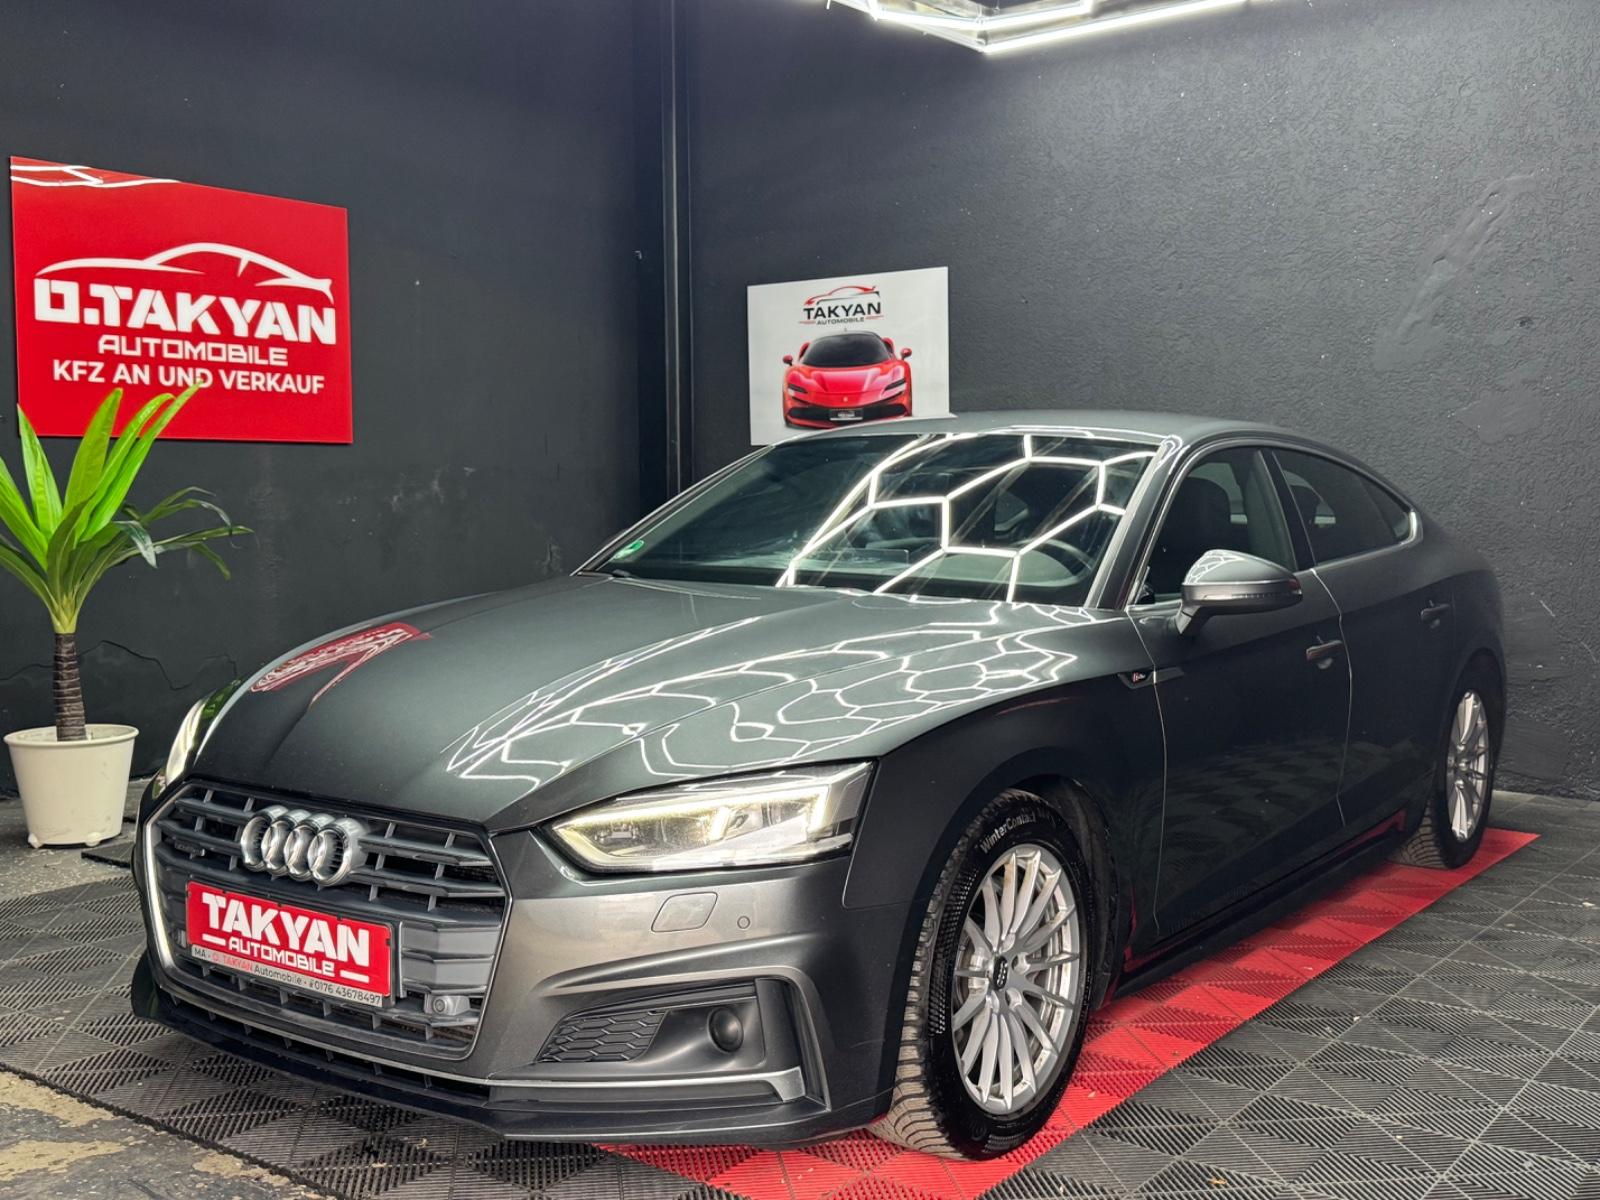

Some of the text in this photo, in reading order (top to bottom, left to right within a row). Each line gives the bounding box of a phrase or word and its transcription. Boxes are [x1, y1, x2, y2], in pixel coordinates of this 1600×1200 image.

[33, 277, 337, 345] O.TAKYAN
[803, 302, 881, 320] TAKYAN
[816, 316, 865, 326] AUTOMOBILE
[97, 333, 289, 367] AUTOMOBILE
[53, 359, 325, 395] KFZ AN UND VERKAUF
[202, 892, 369, 967] TAKYAN
[228, 936, 335, 978] AUTOMOBILE
[254, 965, 303, 984] Automobile
[314, 980, 334, 994] 0176
[335, 987, 381, 1005] 43678497
